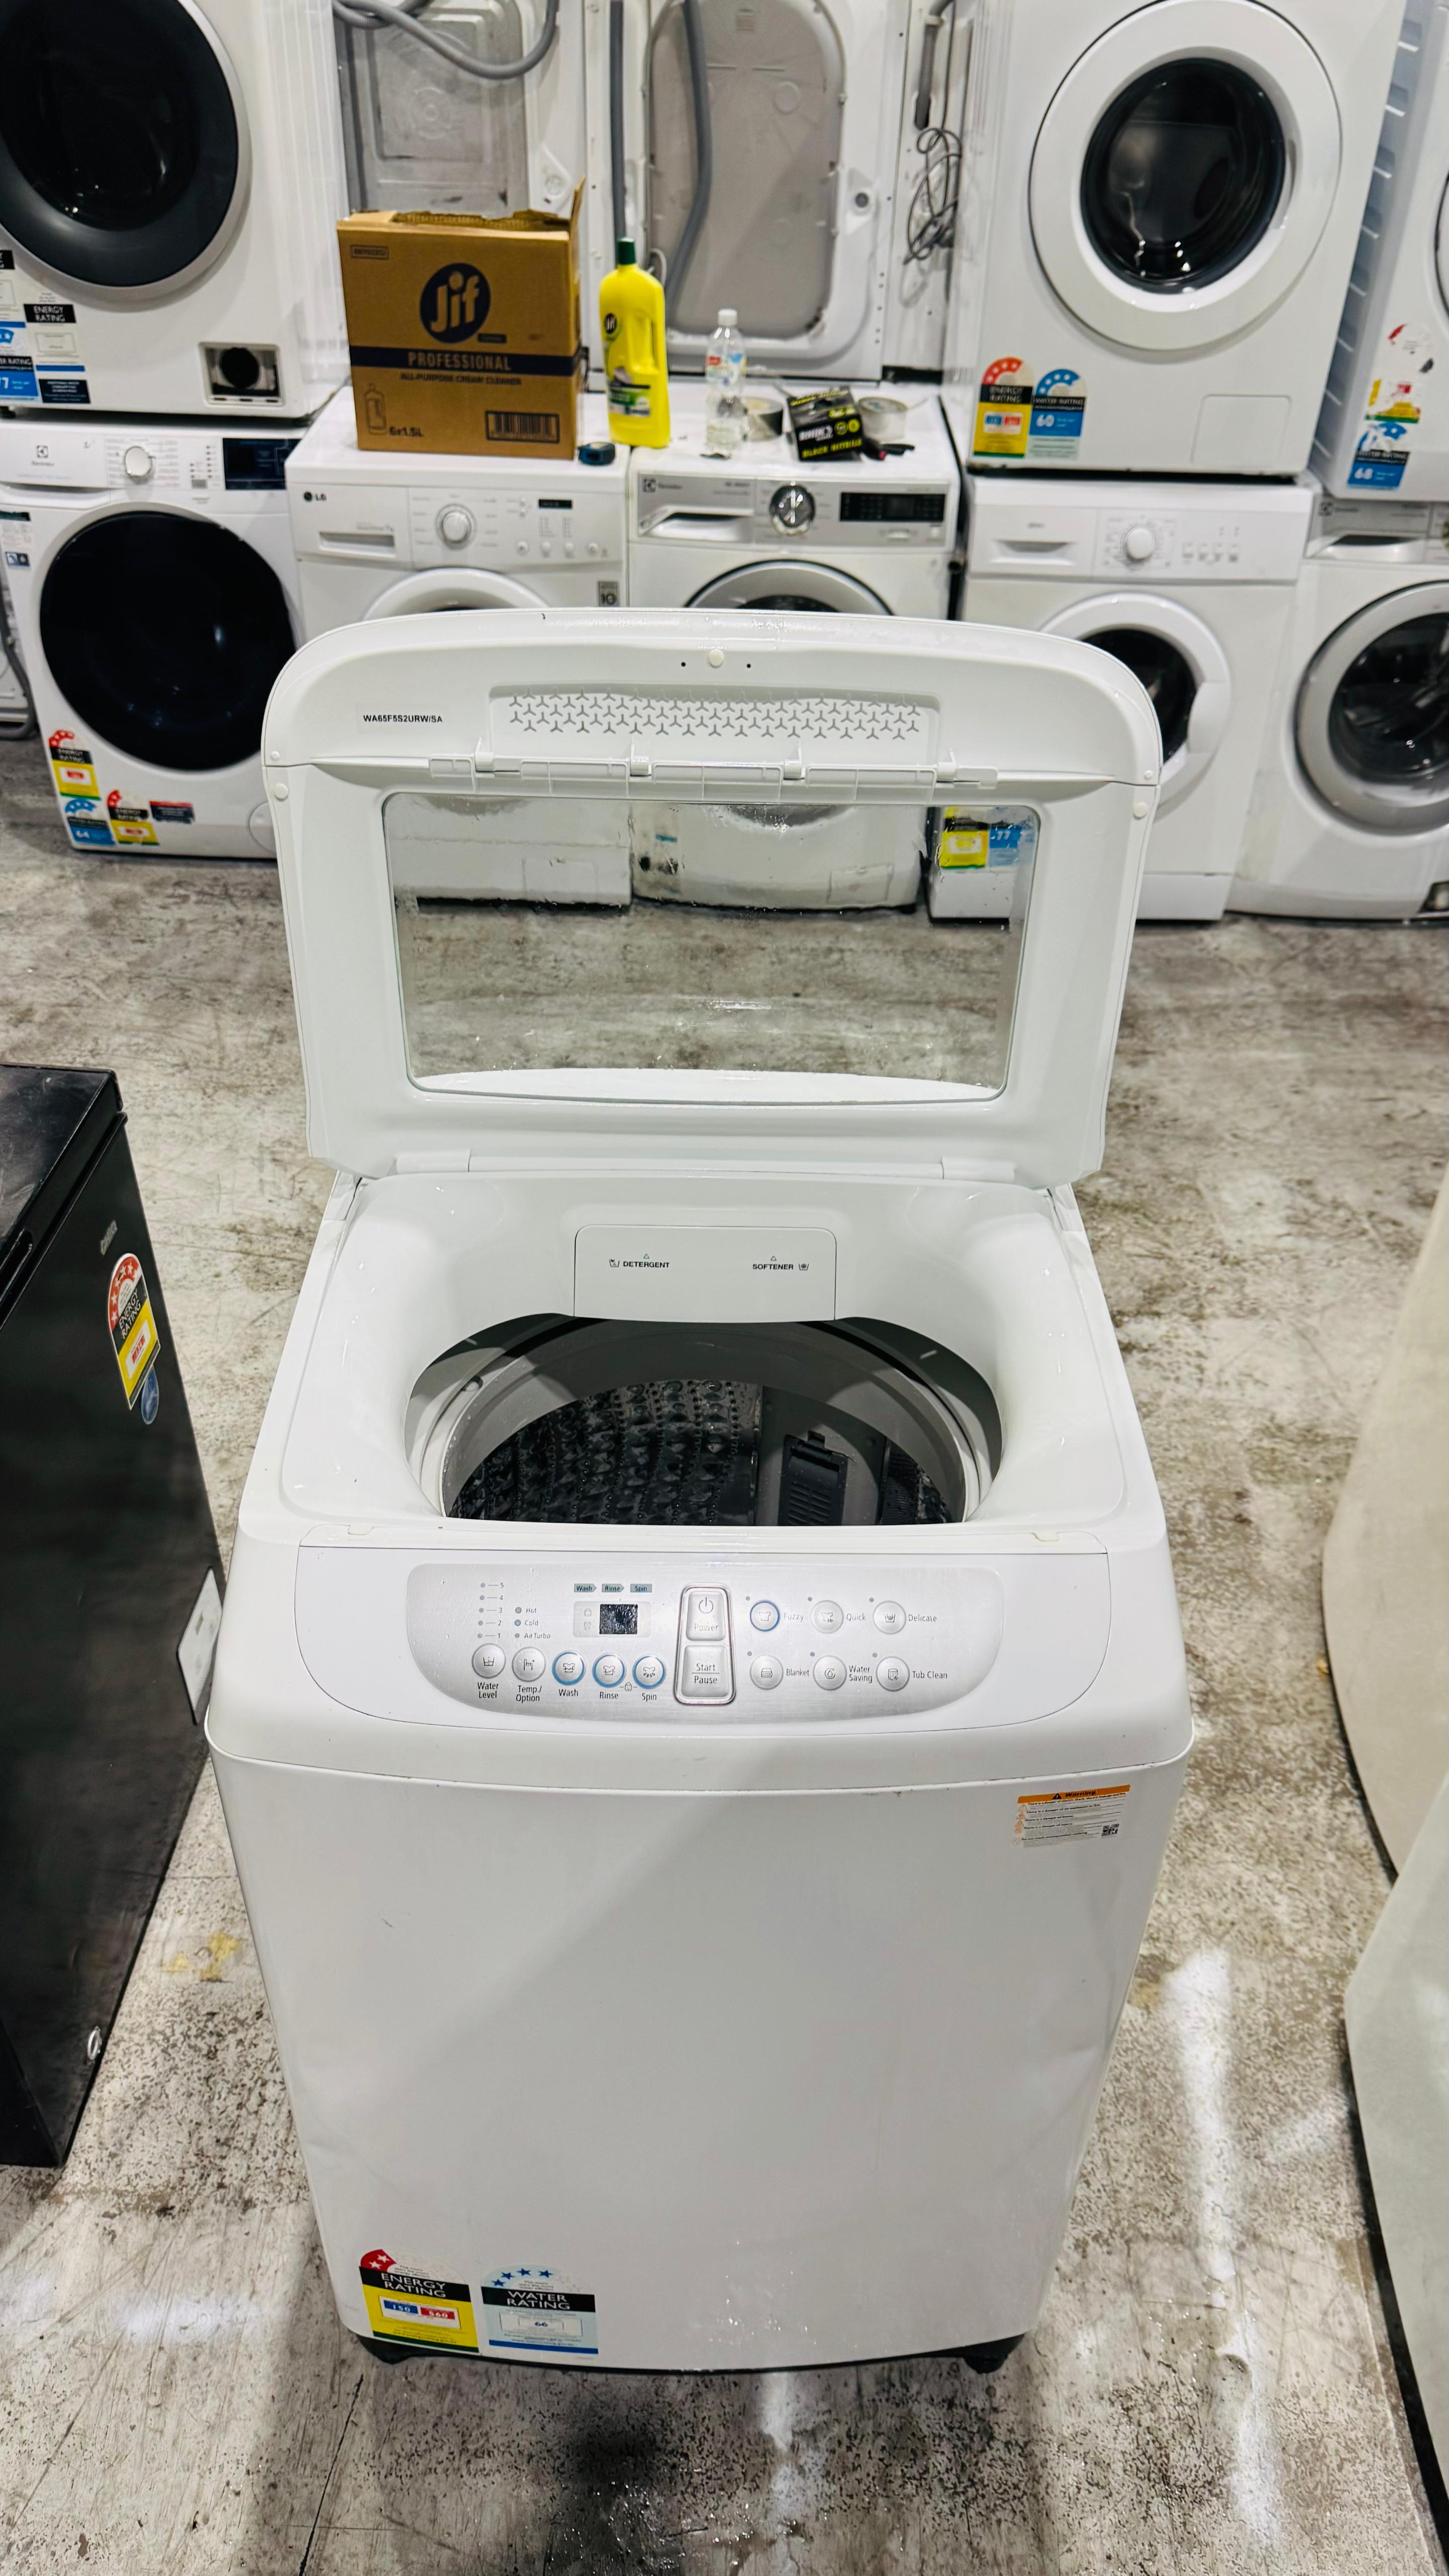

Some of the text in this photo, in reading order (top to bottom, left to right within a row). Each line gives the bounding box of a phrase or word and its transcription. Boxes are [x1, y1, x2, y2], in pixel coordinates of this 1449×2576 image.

[408, 352, 511, 370] PROFESSIONAL
[363, 714, 443, 722] WA65F5S2URW/SA
[119, 1289, 138, 1329] ENERGY
[121, 1300, 141, 1339] RATING
[783, 1613, 804, 1622] Fuzzy
[846, 1613, 866, 1621] Quick
[908, 1614, 937, 1622] Delicate
[694, 1623, 719, 1631] Power
[696, 1663, 715, 1671] Start
[694, 1675, 717, 1683] Pause
[849, 1674, 872, 1683] Saving
[912, 1670, 948, 1679] Tub Clean
[477, 1682, 499, 1691] Water
[479, 1691, 498, 1699] Level
[558, 1688, 579, 1697] Wash
[600, 1692, 618, 1700] Rinse
[641, 1693, 657, 1701] Spin
[516, 1694, 540, 1704] Option
[381, 2273, 446, 2290] ENERGY
[384, 2281, 446, 2297] RATING
[508, 2291, 567, 2302] WATER
[507, 2298, 570, 2310] RATING
